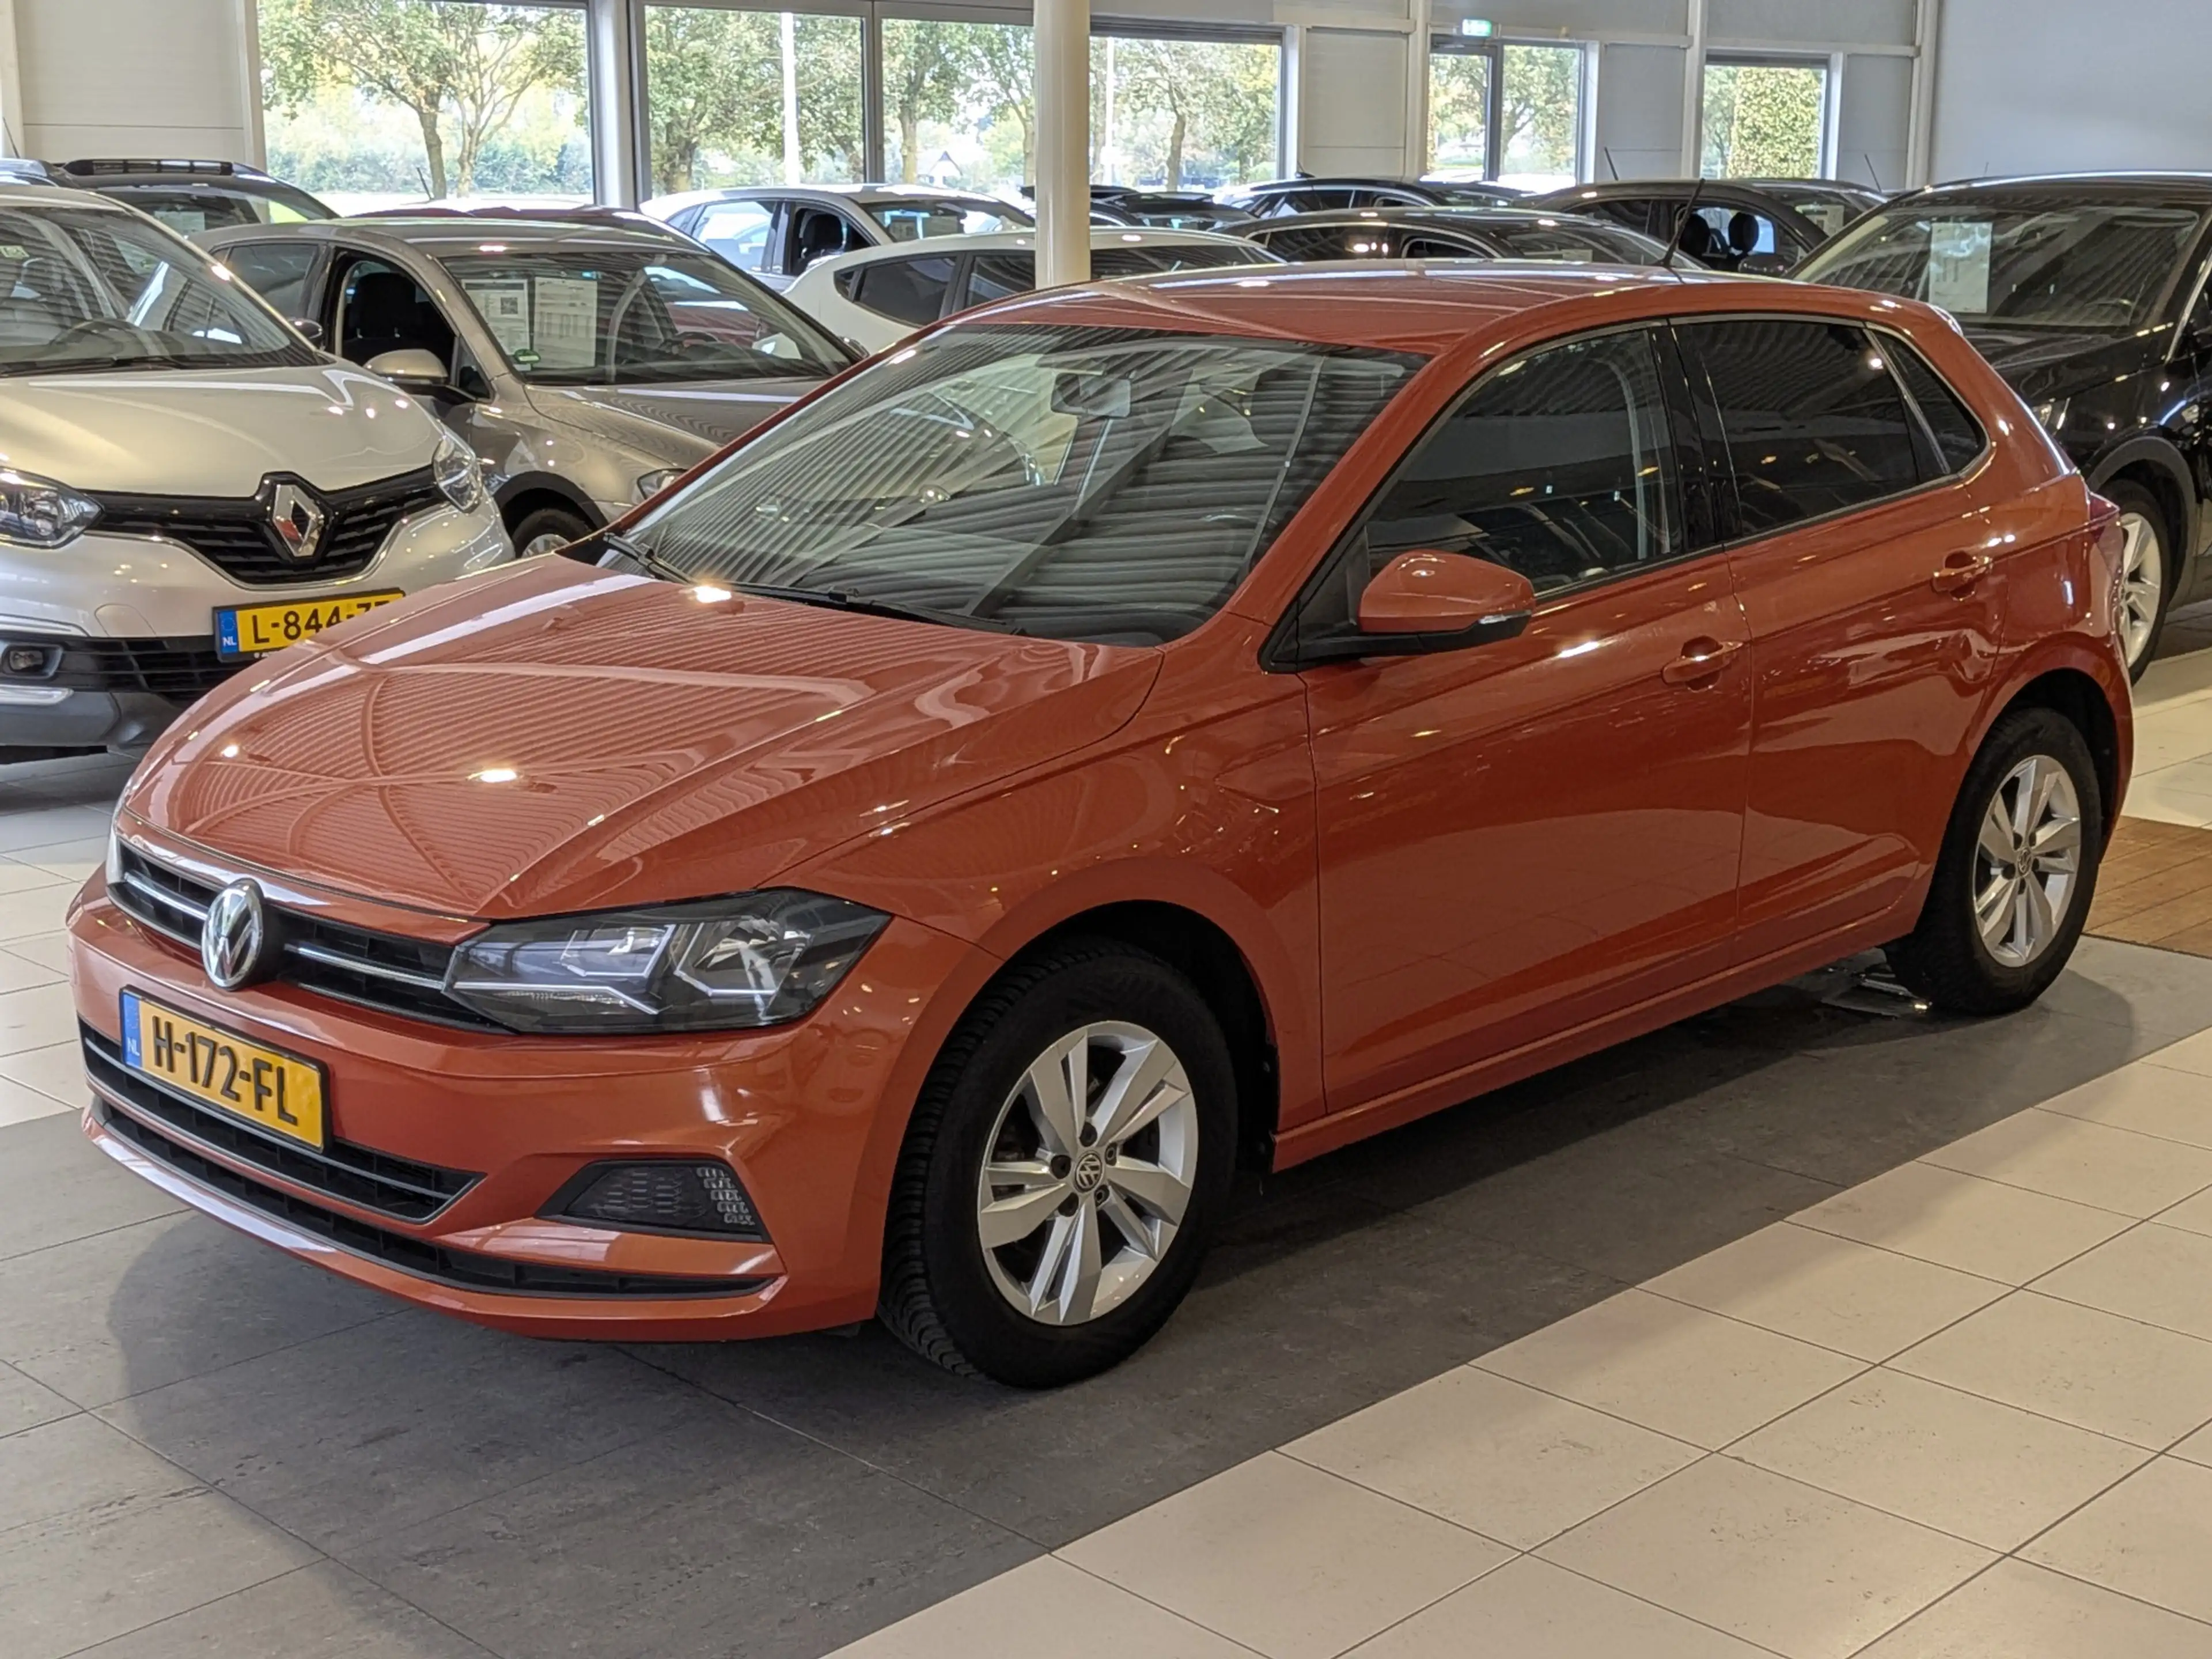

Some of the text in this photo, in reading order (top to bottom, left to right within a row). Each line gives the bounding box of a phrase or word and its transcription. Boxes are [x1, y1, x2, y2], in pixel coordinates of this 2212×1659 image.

[223, 636, 237, 646] NL
[127, 1036, 140, 1056] NL
[152, 1015, 298, 1126] H-172-FL
